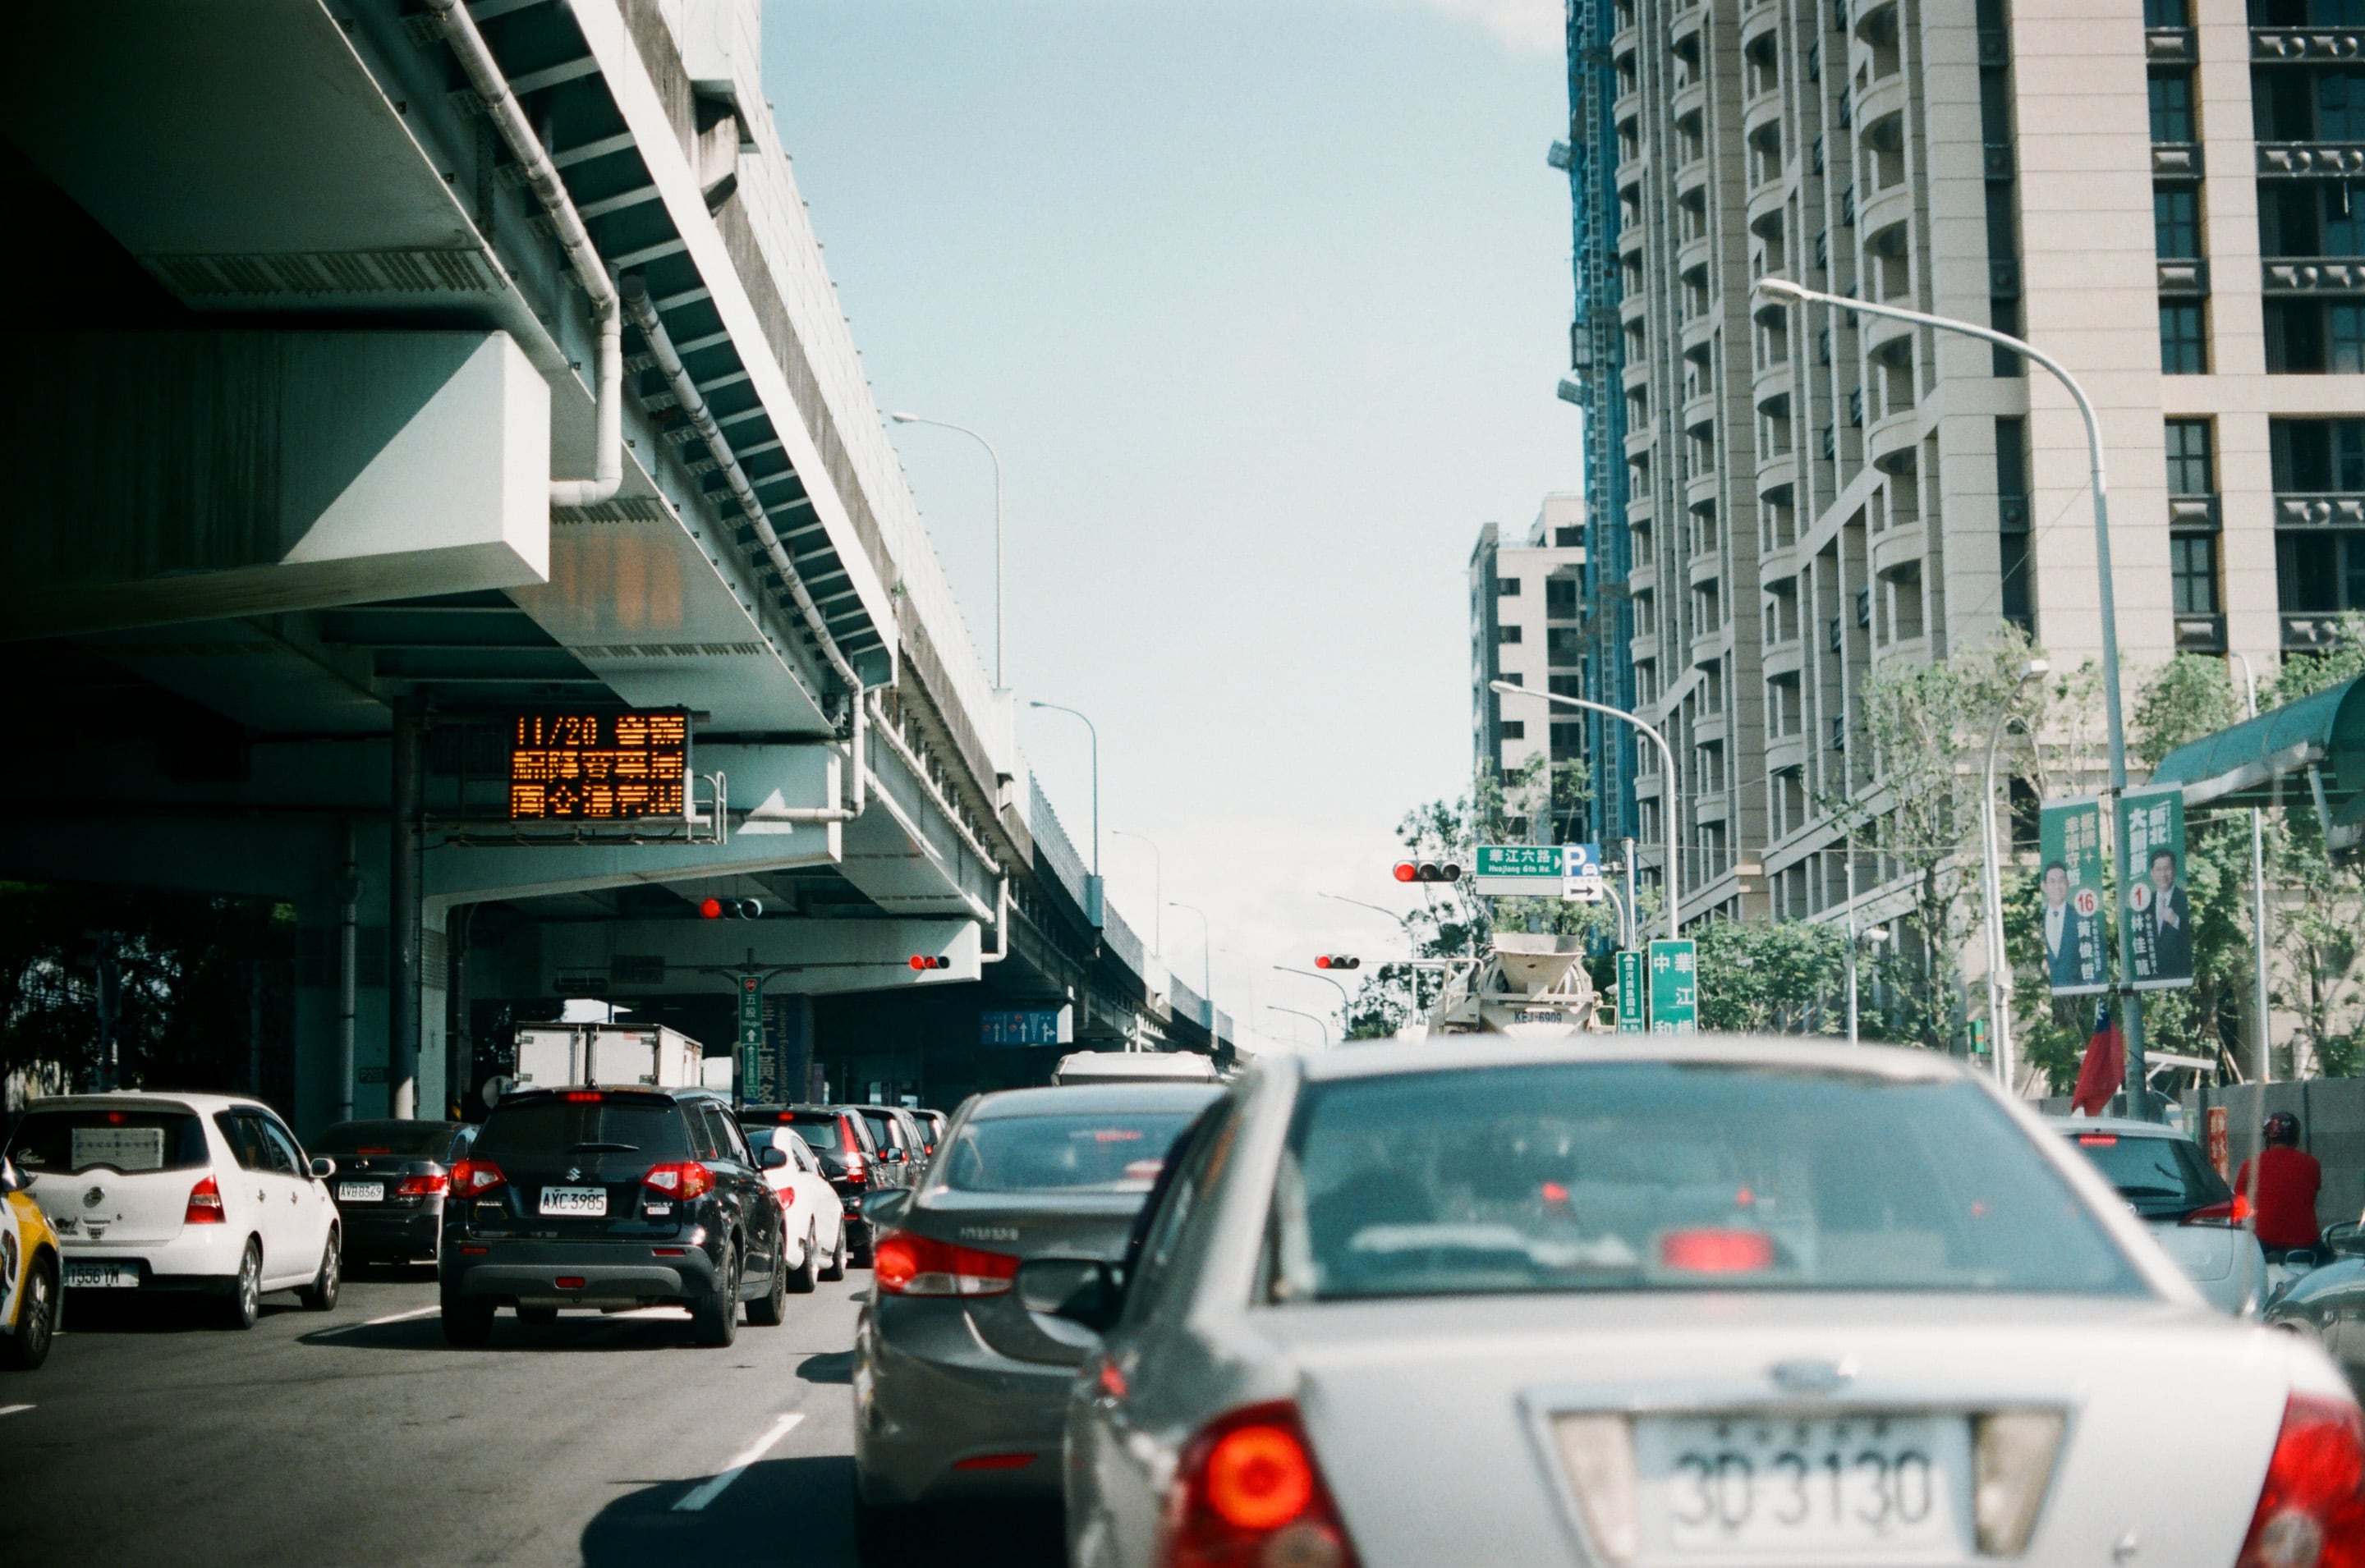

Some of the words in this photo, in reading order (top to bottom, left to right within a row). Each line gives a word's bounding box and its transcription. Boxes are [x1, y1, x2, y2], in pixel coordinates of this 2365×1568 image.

[518, 717, 597, 745] 11/20
[1489, 848, 1550, 863] 華江六路
[1564, 846, 1587, 876] P
[1488, 864, 1520, 874] Huajiang
[1522, 864, 1536, 873] 6th
[1538, 864, 1550, 873] Rd.
[2077, 894, 2095, 913] 16
[2134, 887, 2142, 906] 1
[2130, 915, 2151, 977] 林佳龍
[744, 993, 756, 1018] 五股
[1513, 1011, 1563, 1024] KEJ-6909
